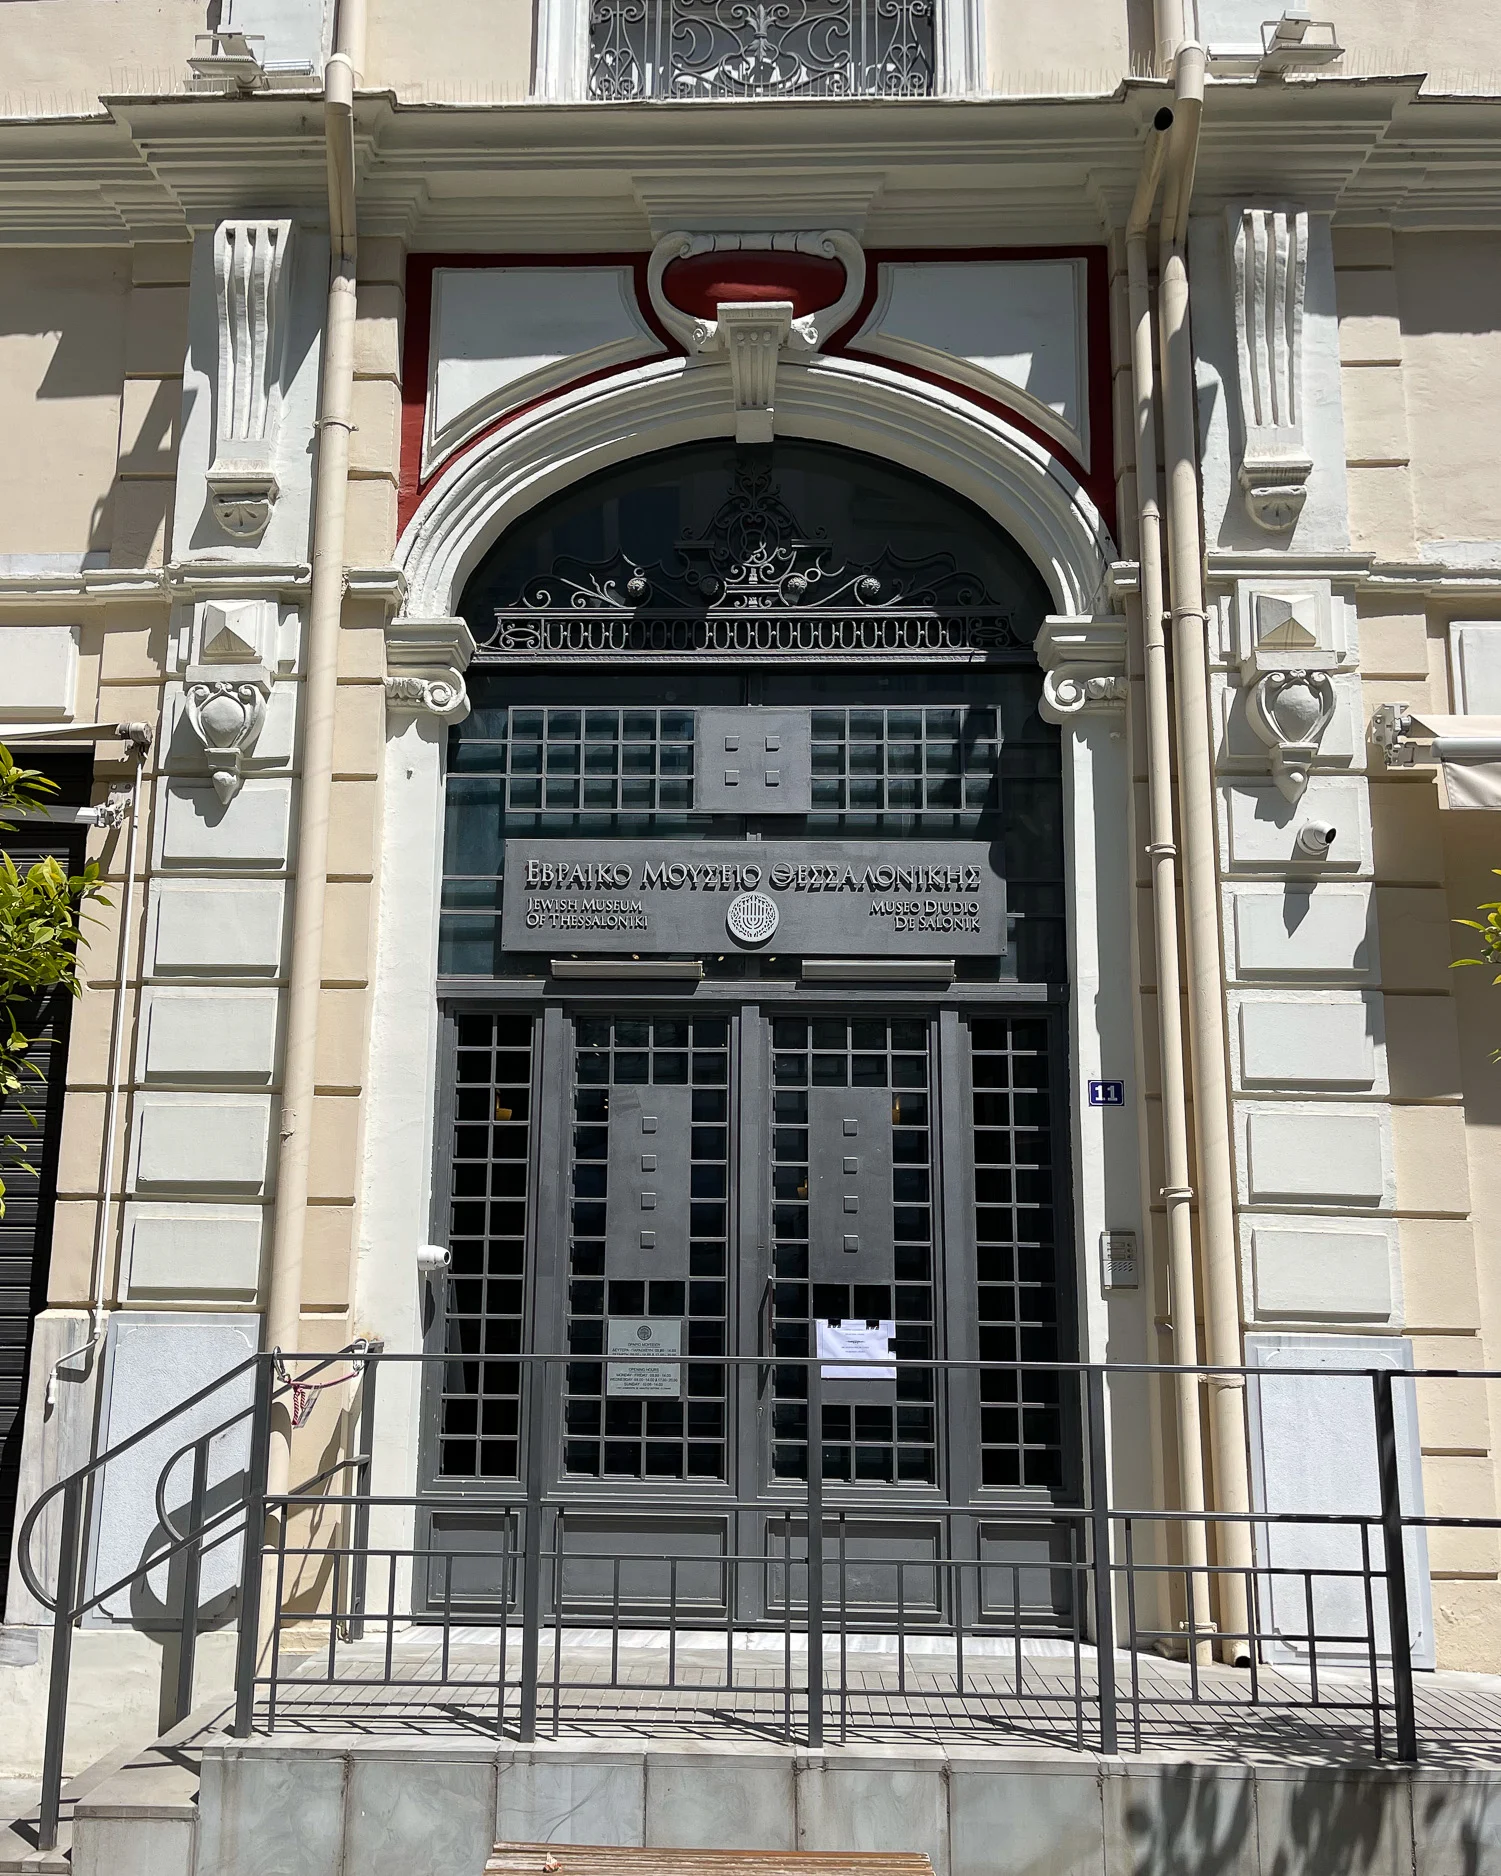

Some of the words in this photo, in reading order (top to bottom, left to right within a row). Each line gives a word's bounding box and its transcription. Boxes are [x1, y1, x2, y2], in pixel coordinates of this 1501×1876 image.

[526, 859, 633, 884] ΕΒΡΑΙΚΟ
[642, 861, 762, 884] ΜΟΥΣΕΙΟ
[771, 862, 982, 885] ΘΕΣΣΑΛΟΝΙΚΗΣ
[527, 897, 578, 912] JEWISH
[581, 898, 643, 911] MUSEUM
[871, 900, 921, 913] MUSEO
[924, 900, 980, 914] DJUDIO
[526, 913, 546, 926] OF
[549, 913, 648, 927] THESSALONIKI
[894, 915, 915, 928] DE
[919, 915, 981, 928] SALONIK
[1094, 1084, 1118, 1101] 11
